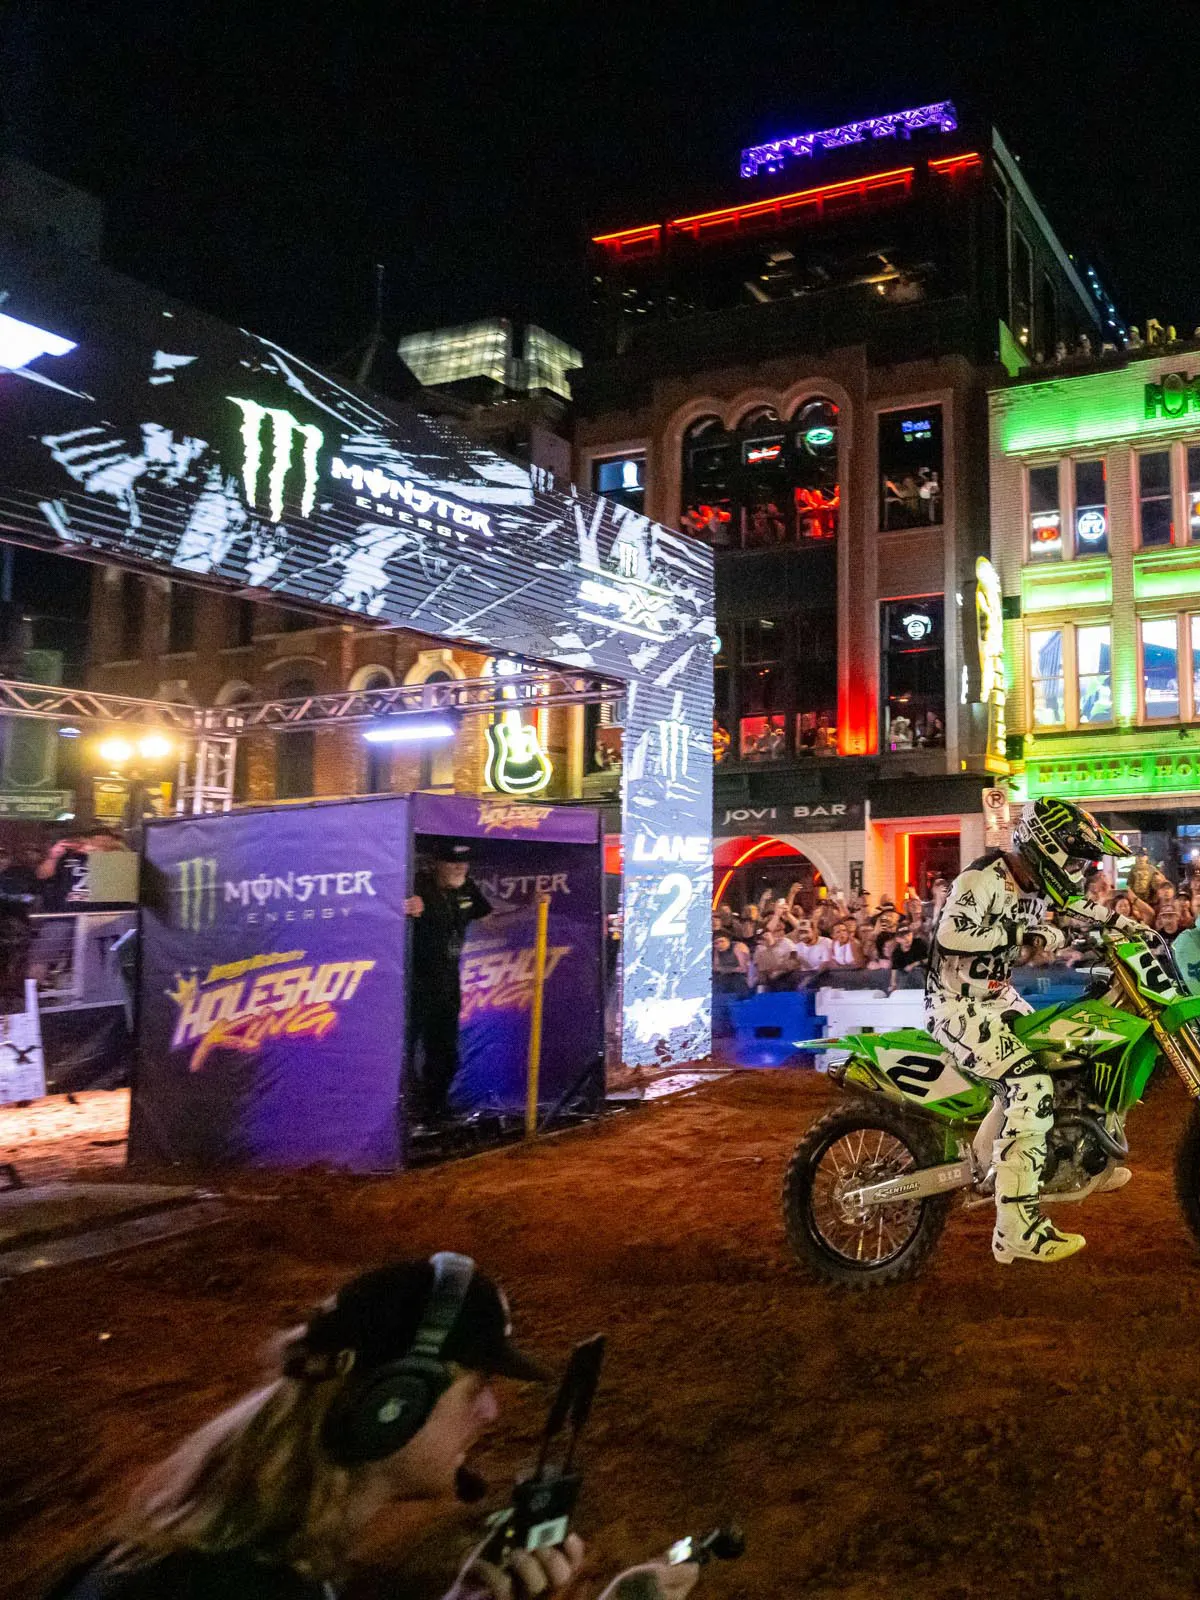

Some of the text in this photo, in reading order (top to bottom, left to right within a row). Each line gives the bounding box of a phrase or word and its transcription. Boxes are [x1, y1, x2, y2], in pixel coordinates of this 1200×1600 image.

[331, 456, 494, 537] MONSTER
[355, 495, 469, 542] ENERGY
[721, 804, 847, 825] JOVI BAR
[632, 834, 710, 862] LANE
[224, 870, 377, 906] MONSTER
[478, 872, 571, 900] NSTER
[247, 906, 351, 924] ENERGY
[651, 872, 693, 937] 2
[172, 960, 377, 1046] HOLESHOT
[1071, 1008, 1124, 1030] KX
[190, 1001, 338, 1072] KING
[886, 1055, 945, 1097] 2
[1013, 1058, 1037, 1075] CASH
